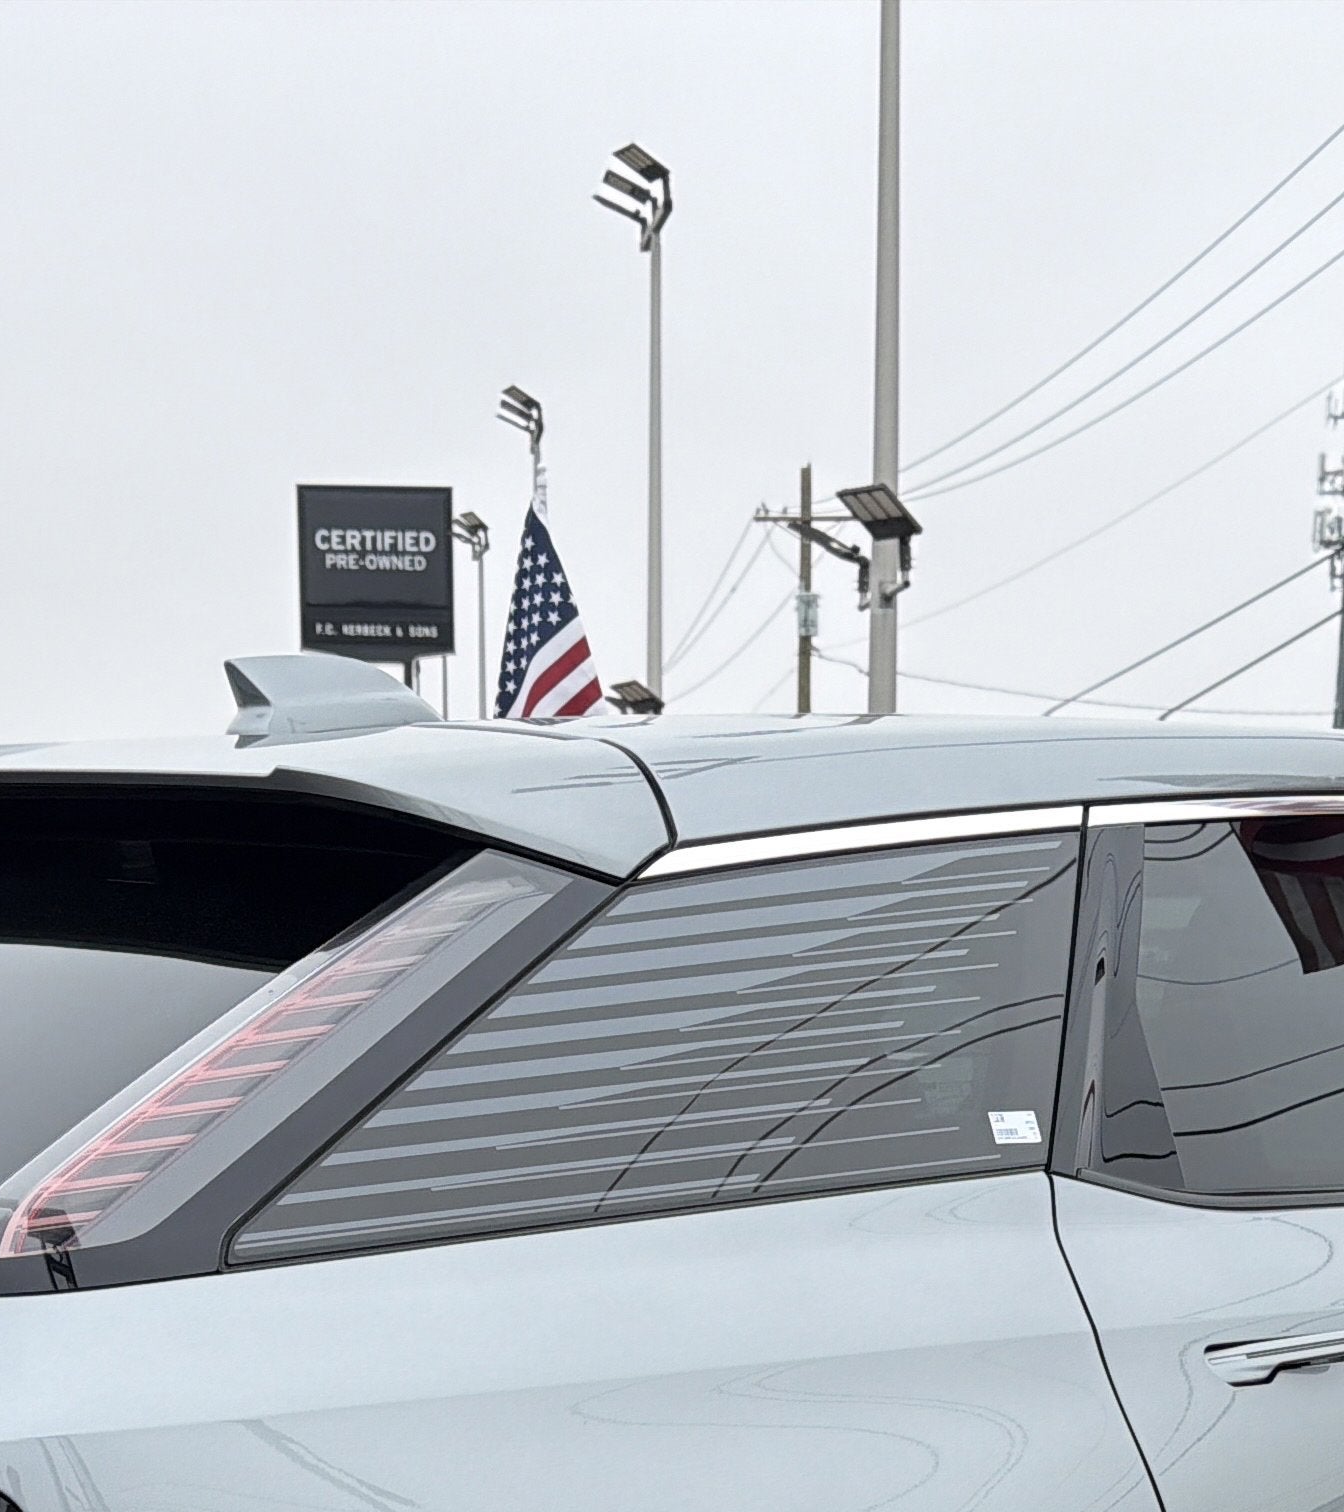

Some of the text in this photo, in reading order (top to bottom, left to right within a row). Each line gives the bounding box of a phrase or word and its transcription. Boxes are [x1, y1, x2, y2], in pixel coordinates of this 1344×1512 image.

[314, 527, 437, 552] CERTIFIED
[324, 553, 428, 571] PRE-OWNED
[408, 625, 439, 638] SONS
